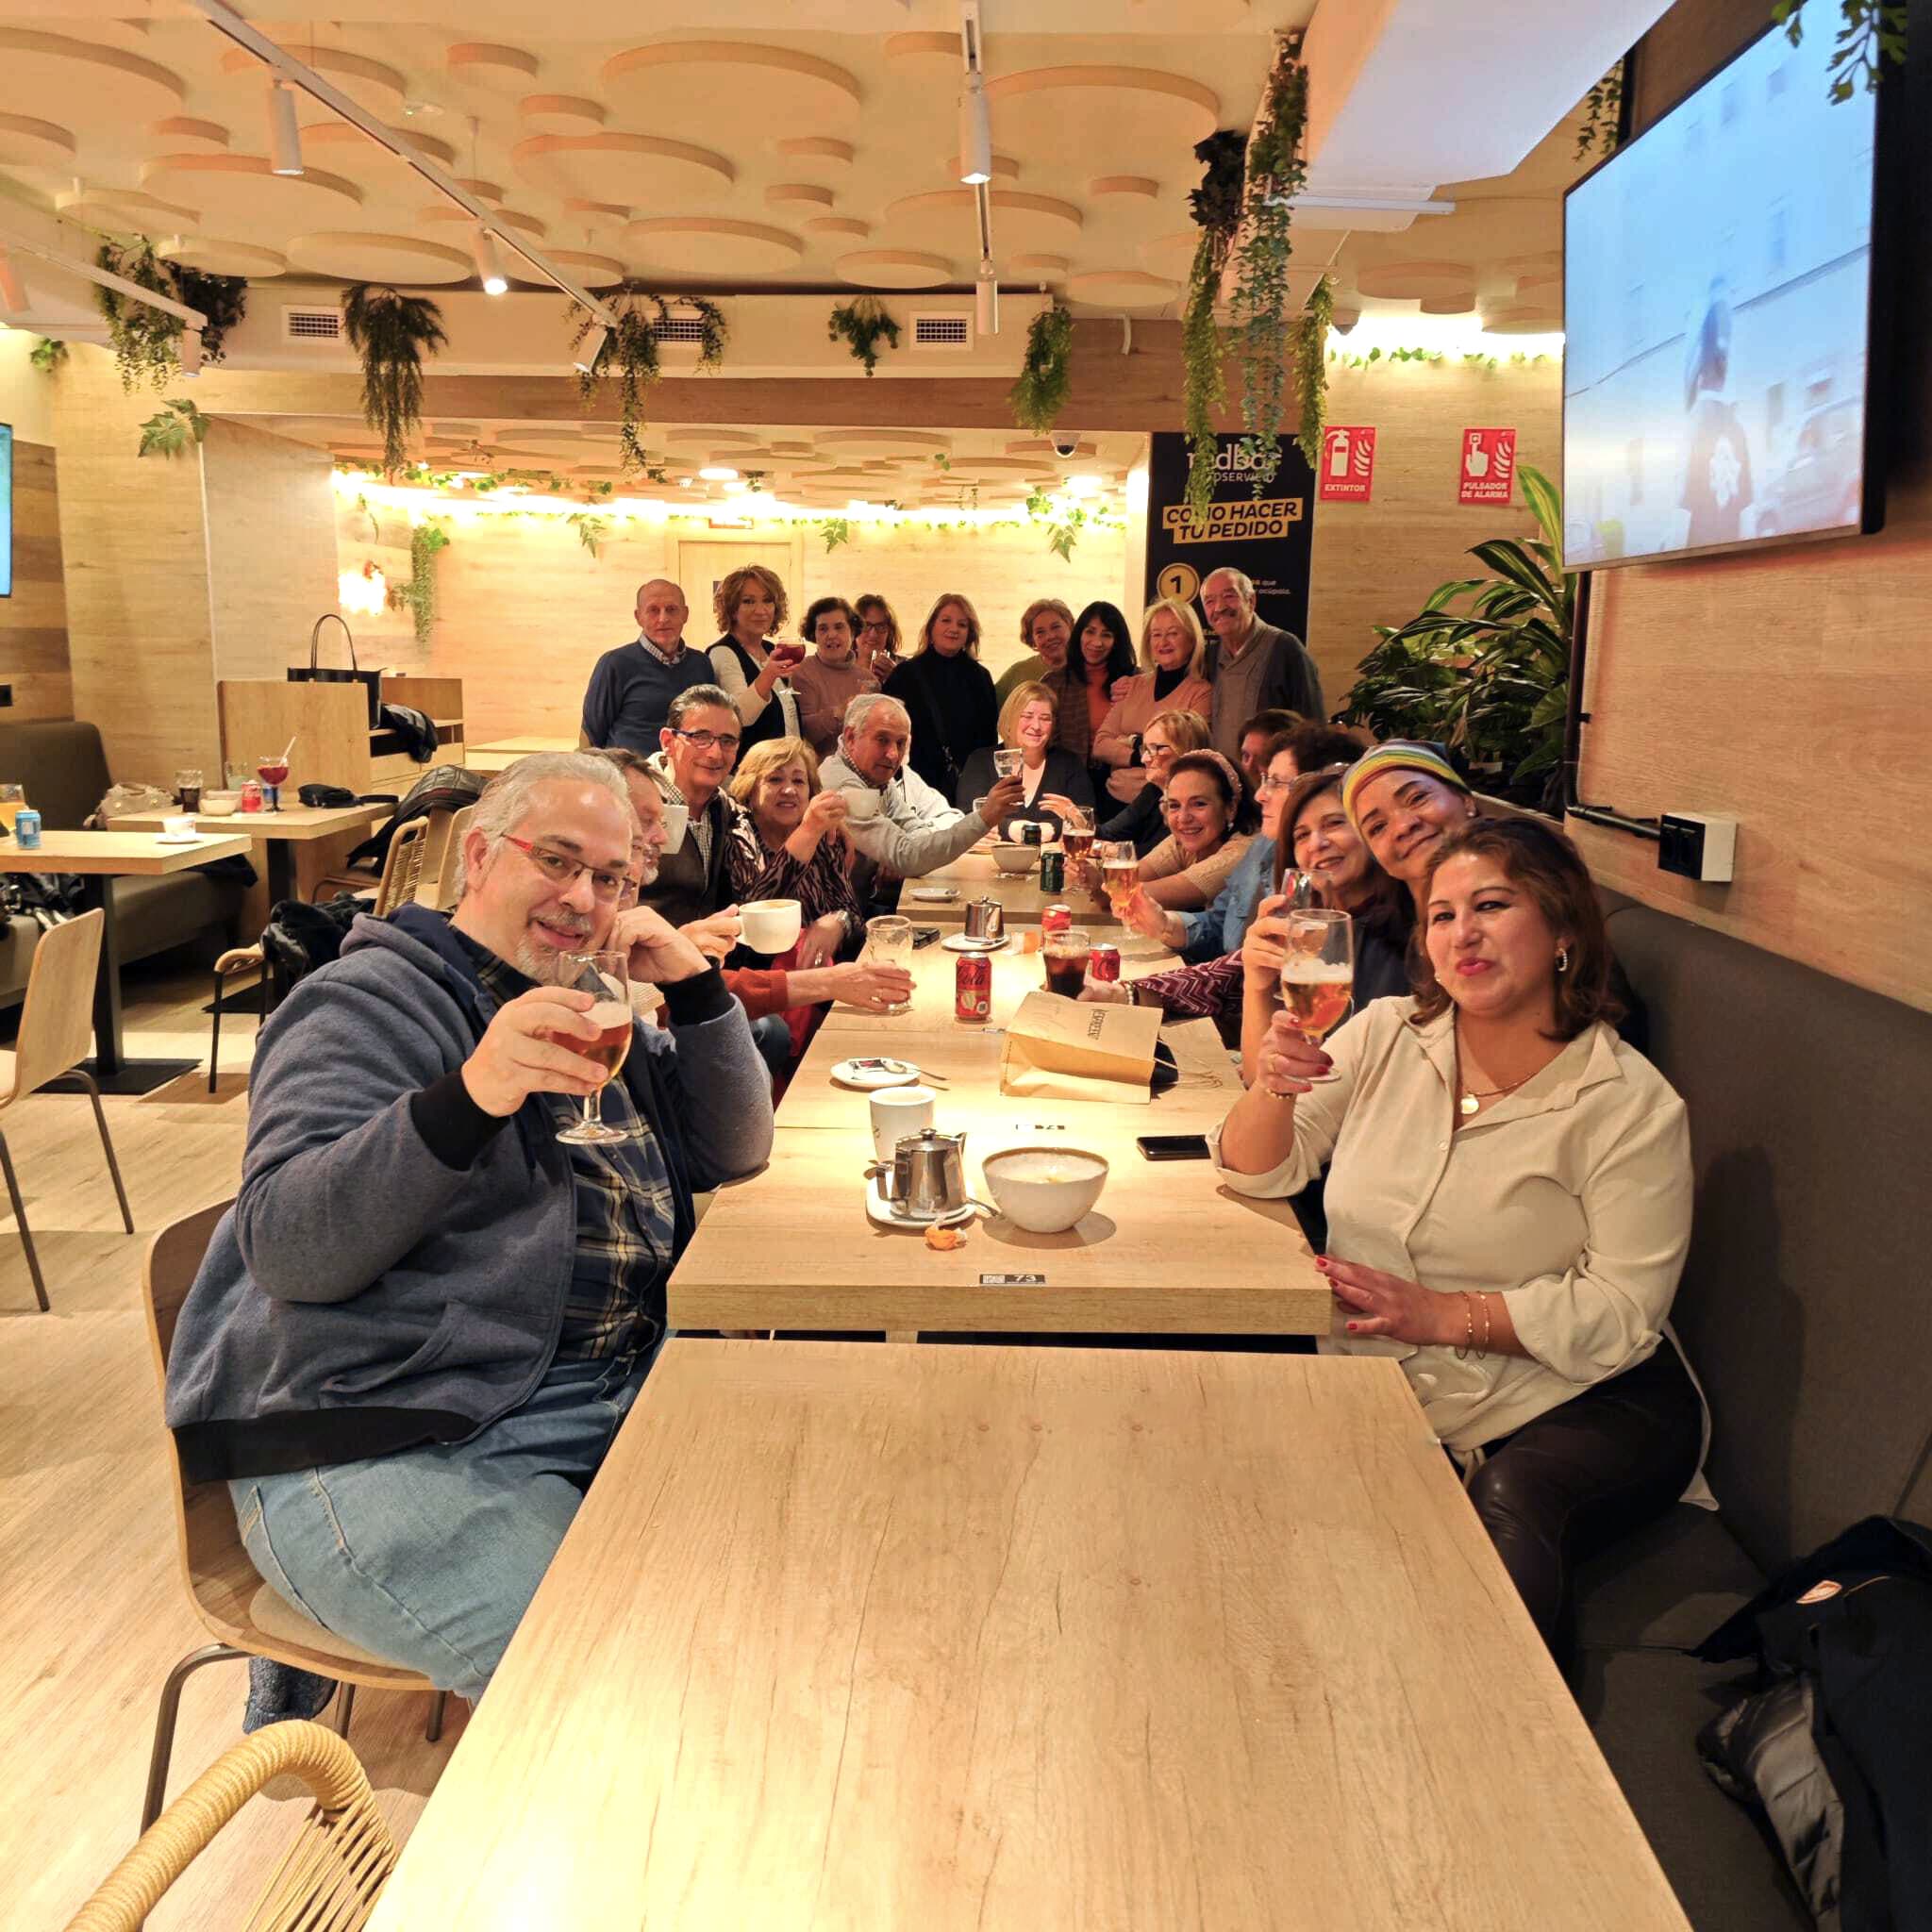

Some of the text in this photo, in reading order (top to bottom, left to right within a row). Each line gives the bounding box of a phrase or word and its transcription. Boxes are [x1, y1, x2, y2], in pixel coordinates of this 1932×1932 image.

[1463, 482, 1507, 491] PULSADOR
[1166, 502, 1297, 523] COO HACER
[1179, 520, 1283, 540] TU PEDIDO
[1170, 575, 1181, 594] 1
[1013, 1274, 1037, 1283] 73
